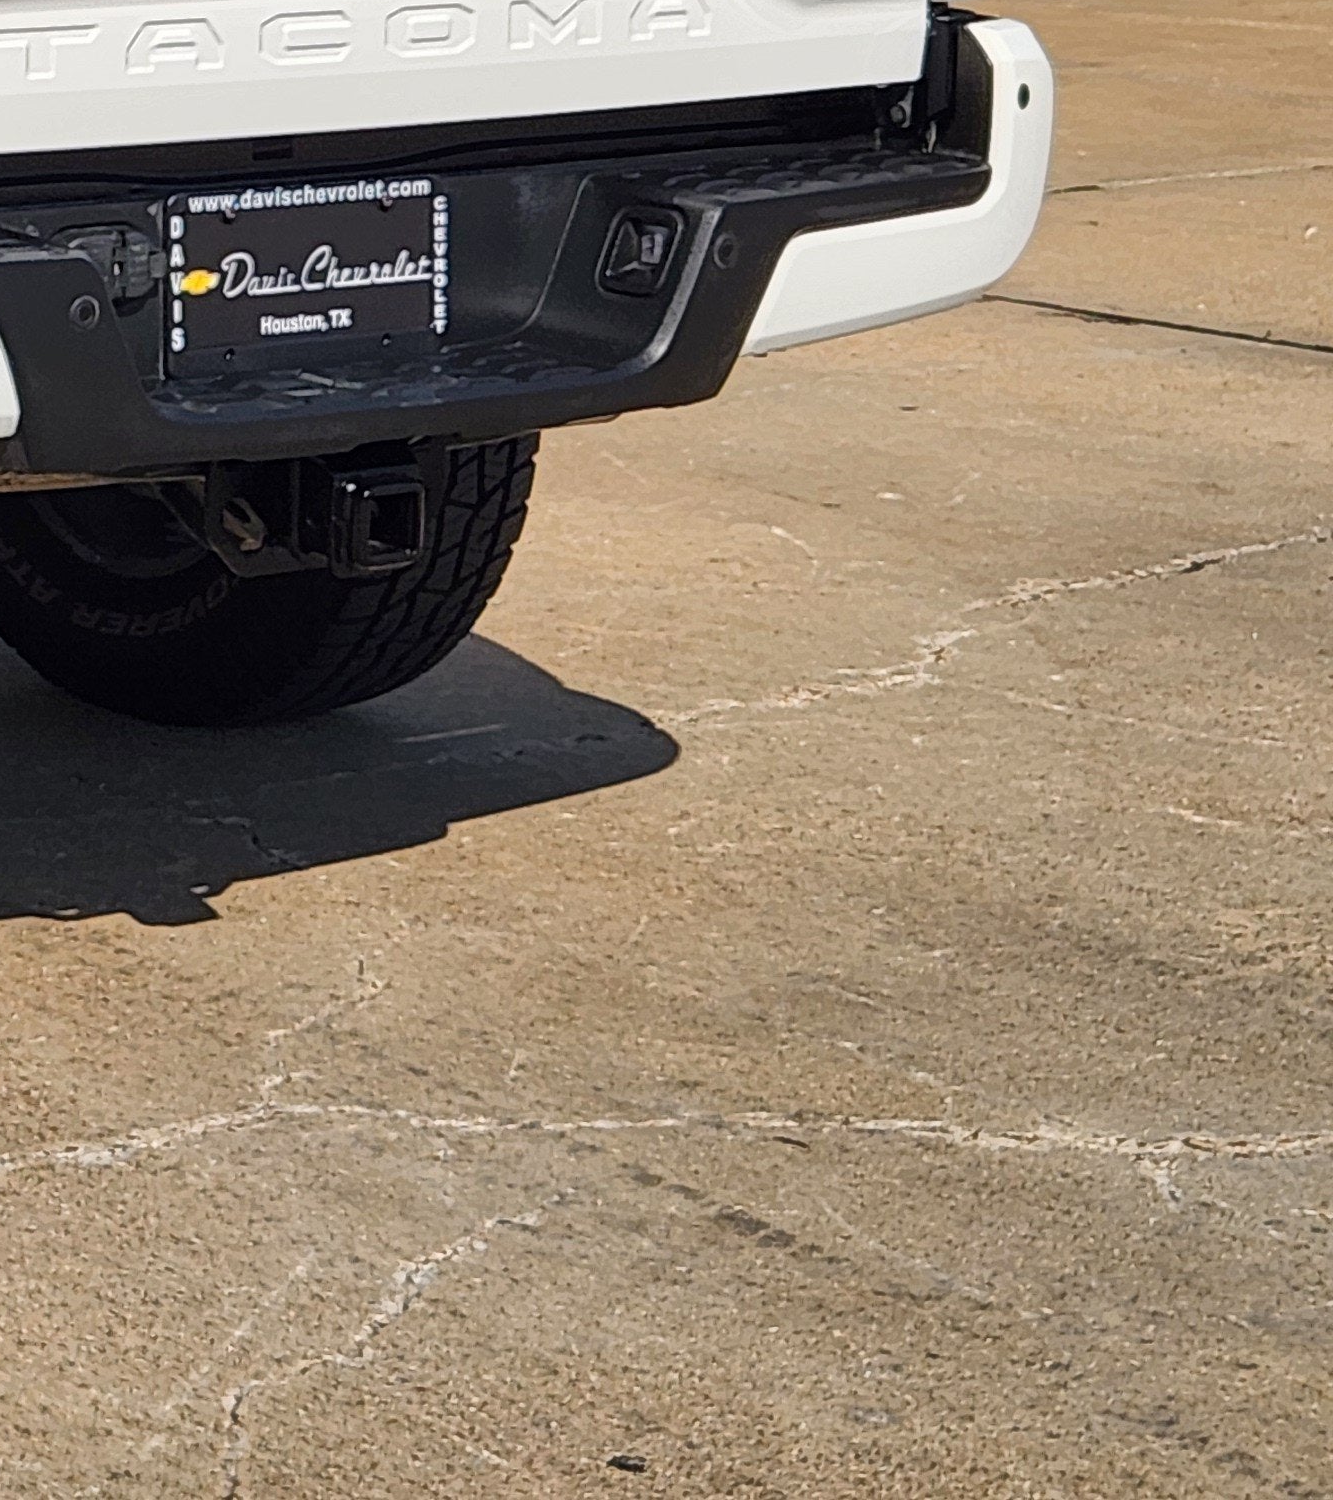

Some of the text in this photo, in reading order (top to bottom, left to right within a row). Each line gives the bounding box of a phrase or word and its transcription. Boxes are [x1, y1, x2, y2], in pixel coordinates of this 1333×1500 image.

[188, 179, 432, 213] www.davischevrolet.com
[170, 215, 185, 352] DAVIS
[220, 244, 432, 299] Davis Chevrolet
[432, 195, 449, 335] CHEVROLET
[260, 307, 353, 337] Houston, TX
